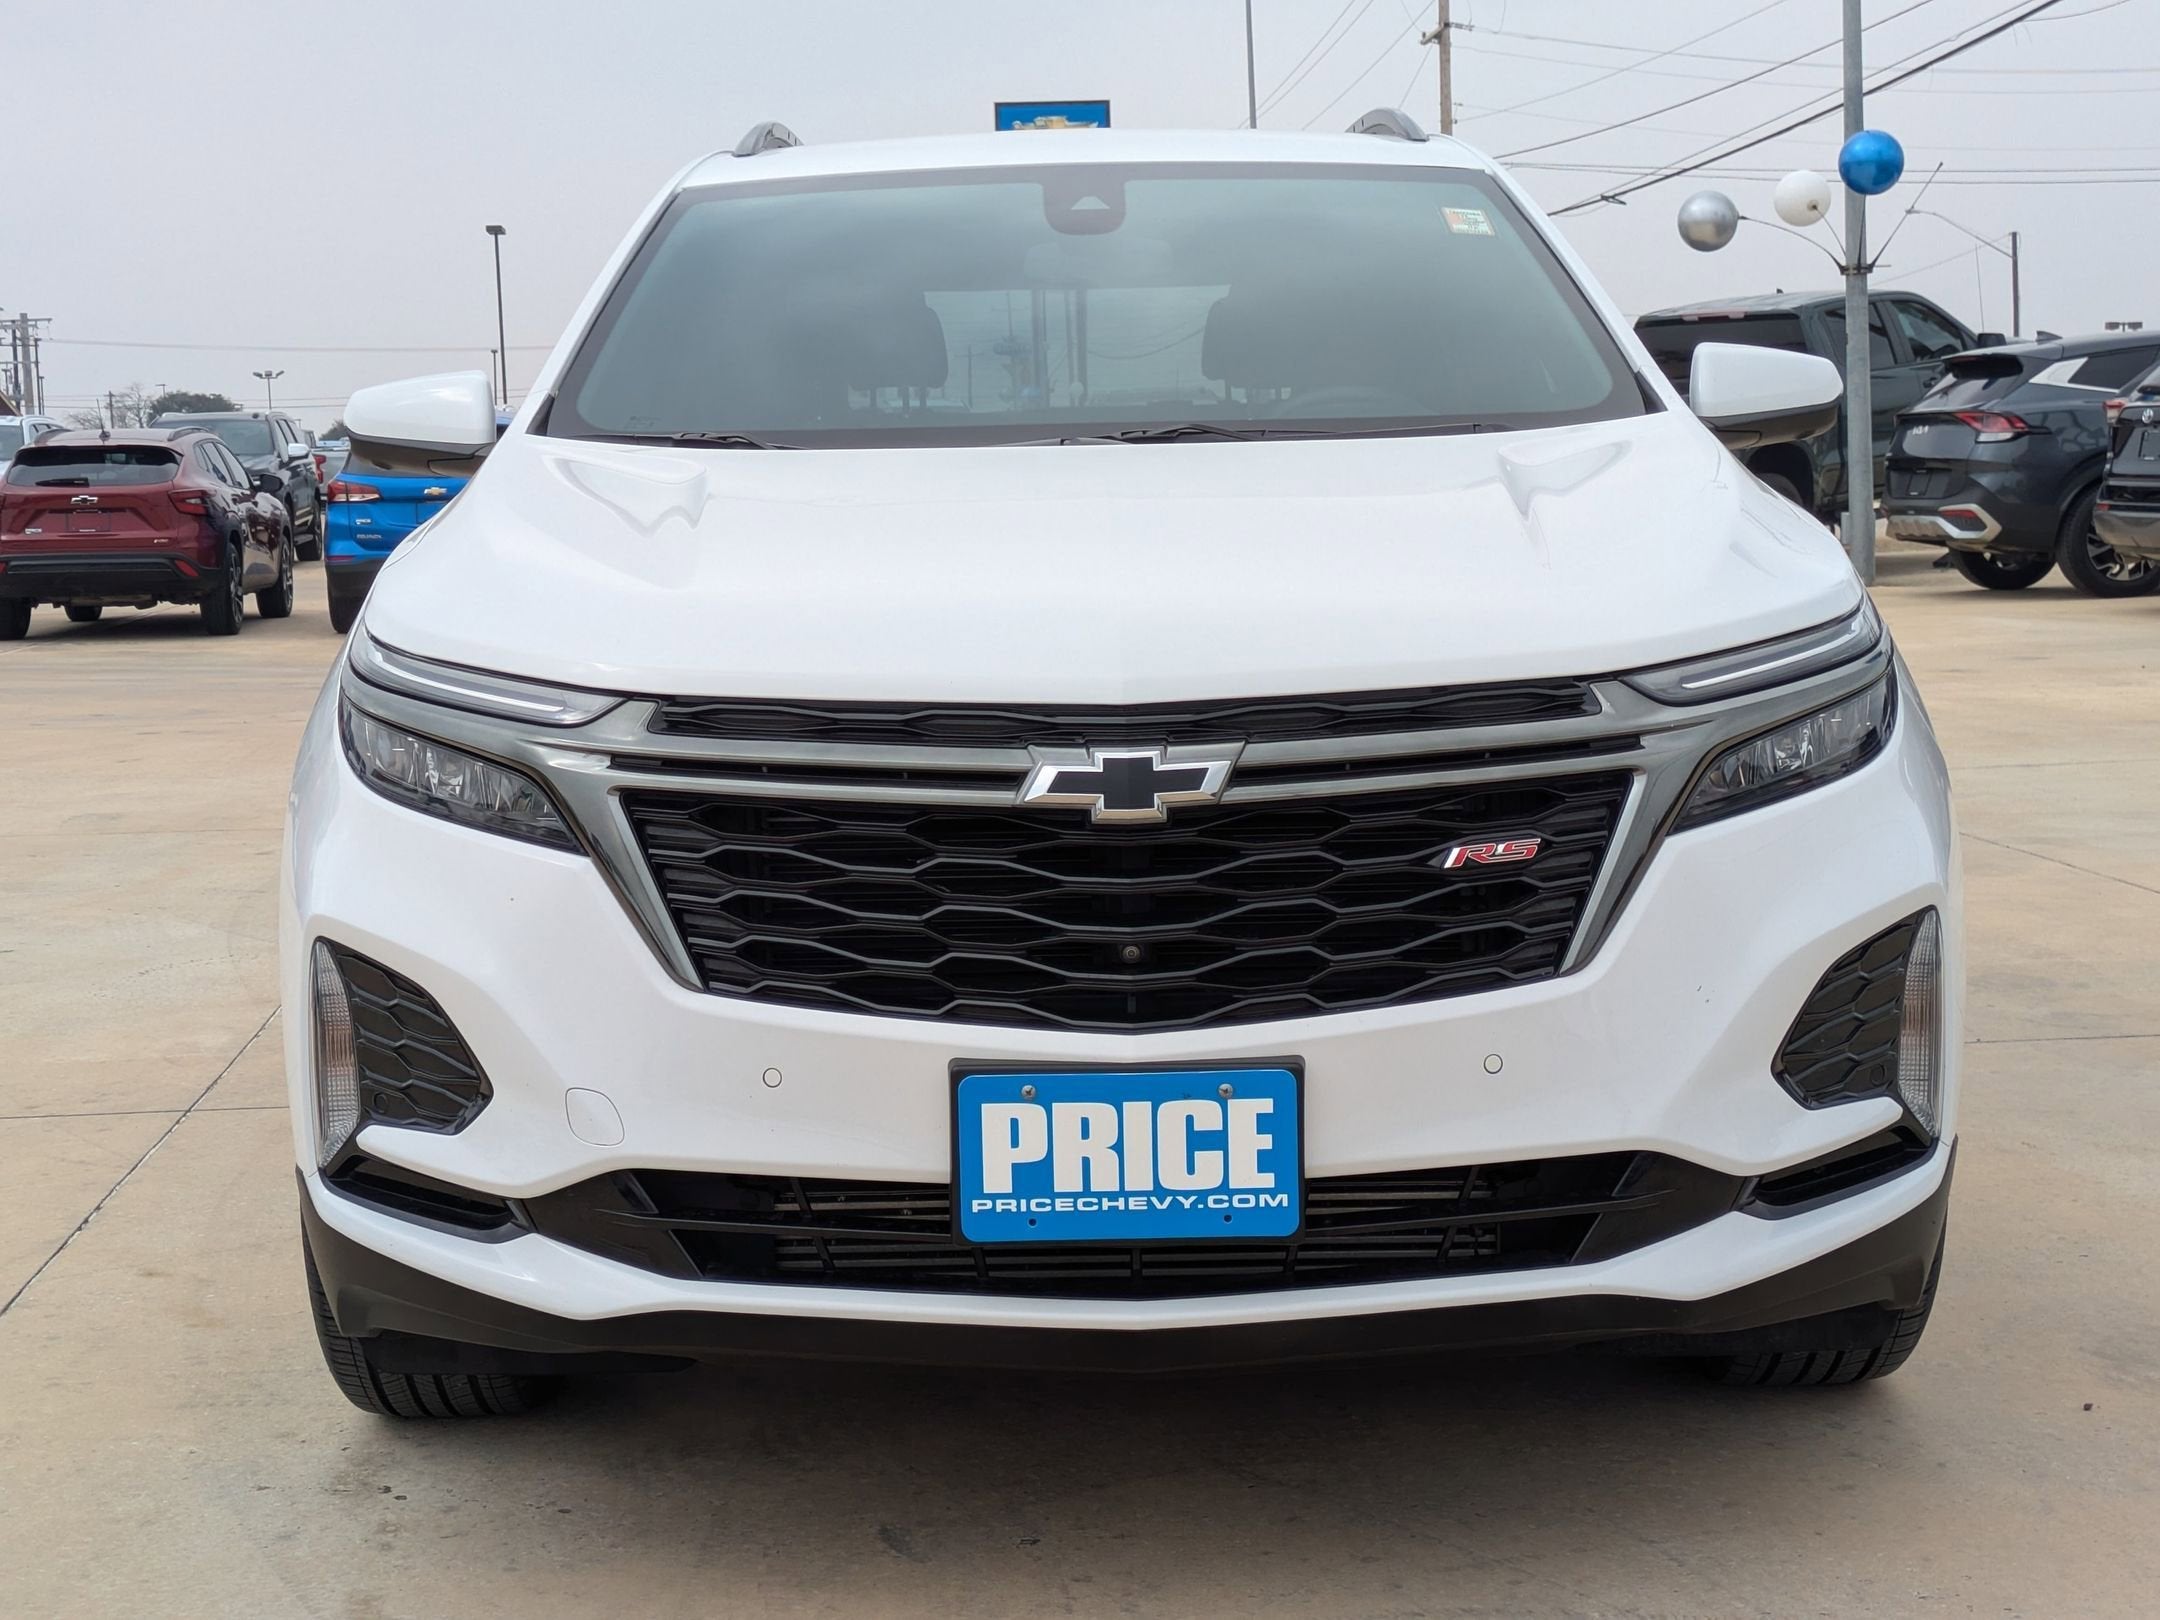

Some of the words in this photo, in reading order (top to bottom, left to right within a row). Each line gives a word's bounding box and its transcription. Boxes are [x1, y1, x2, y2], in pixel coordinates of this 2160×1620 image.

[1444, 838, 1541, 868] RS
[981, 1098, 1275, 1193] PRICE
[971, 1194, 1289, 1213] PRICECHEVY.COM
